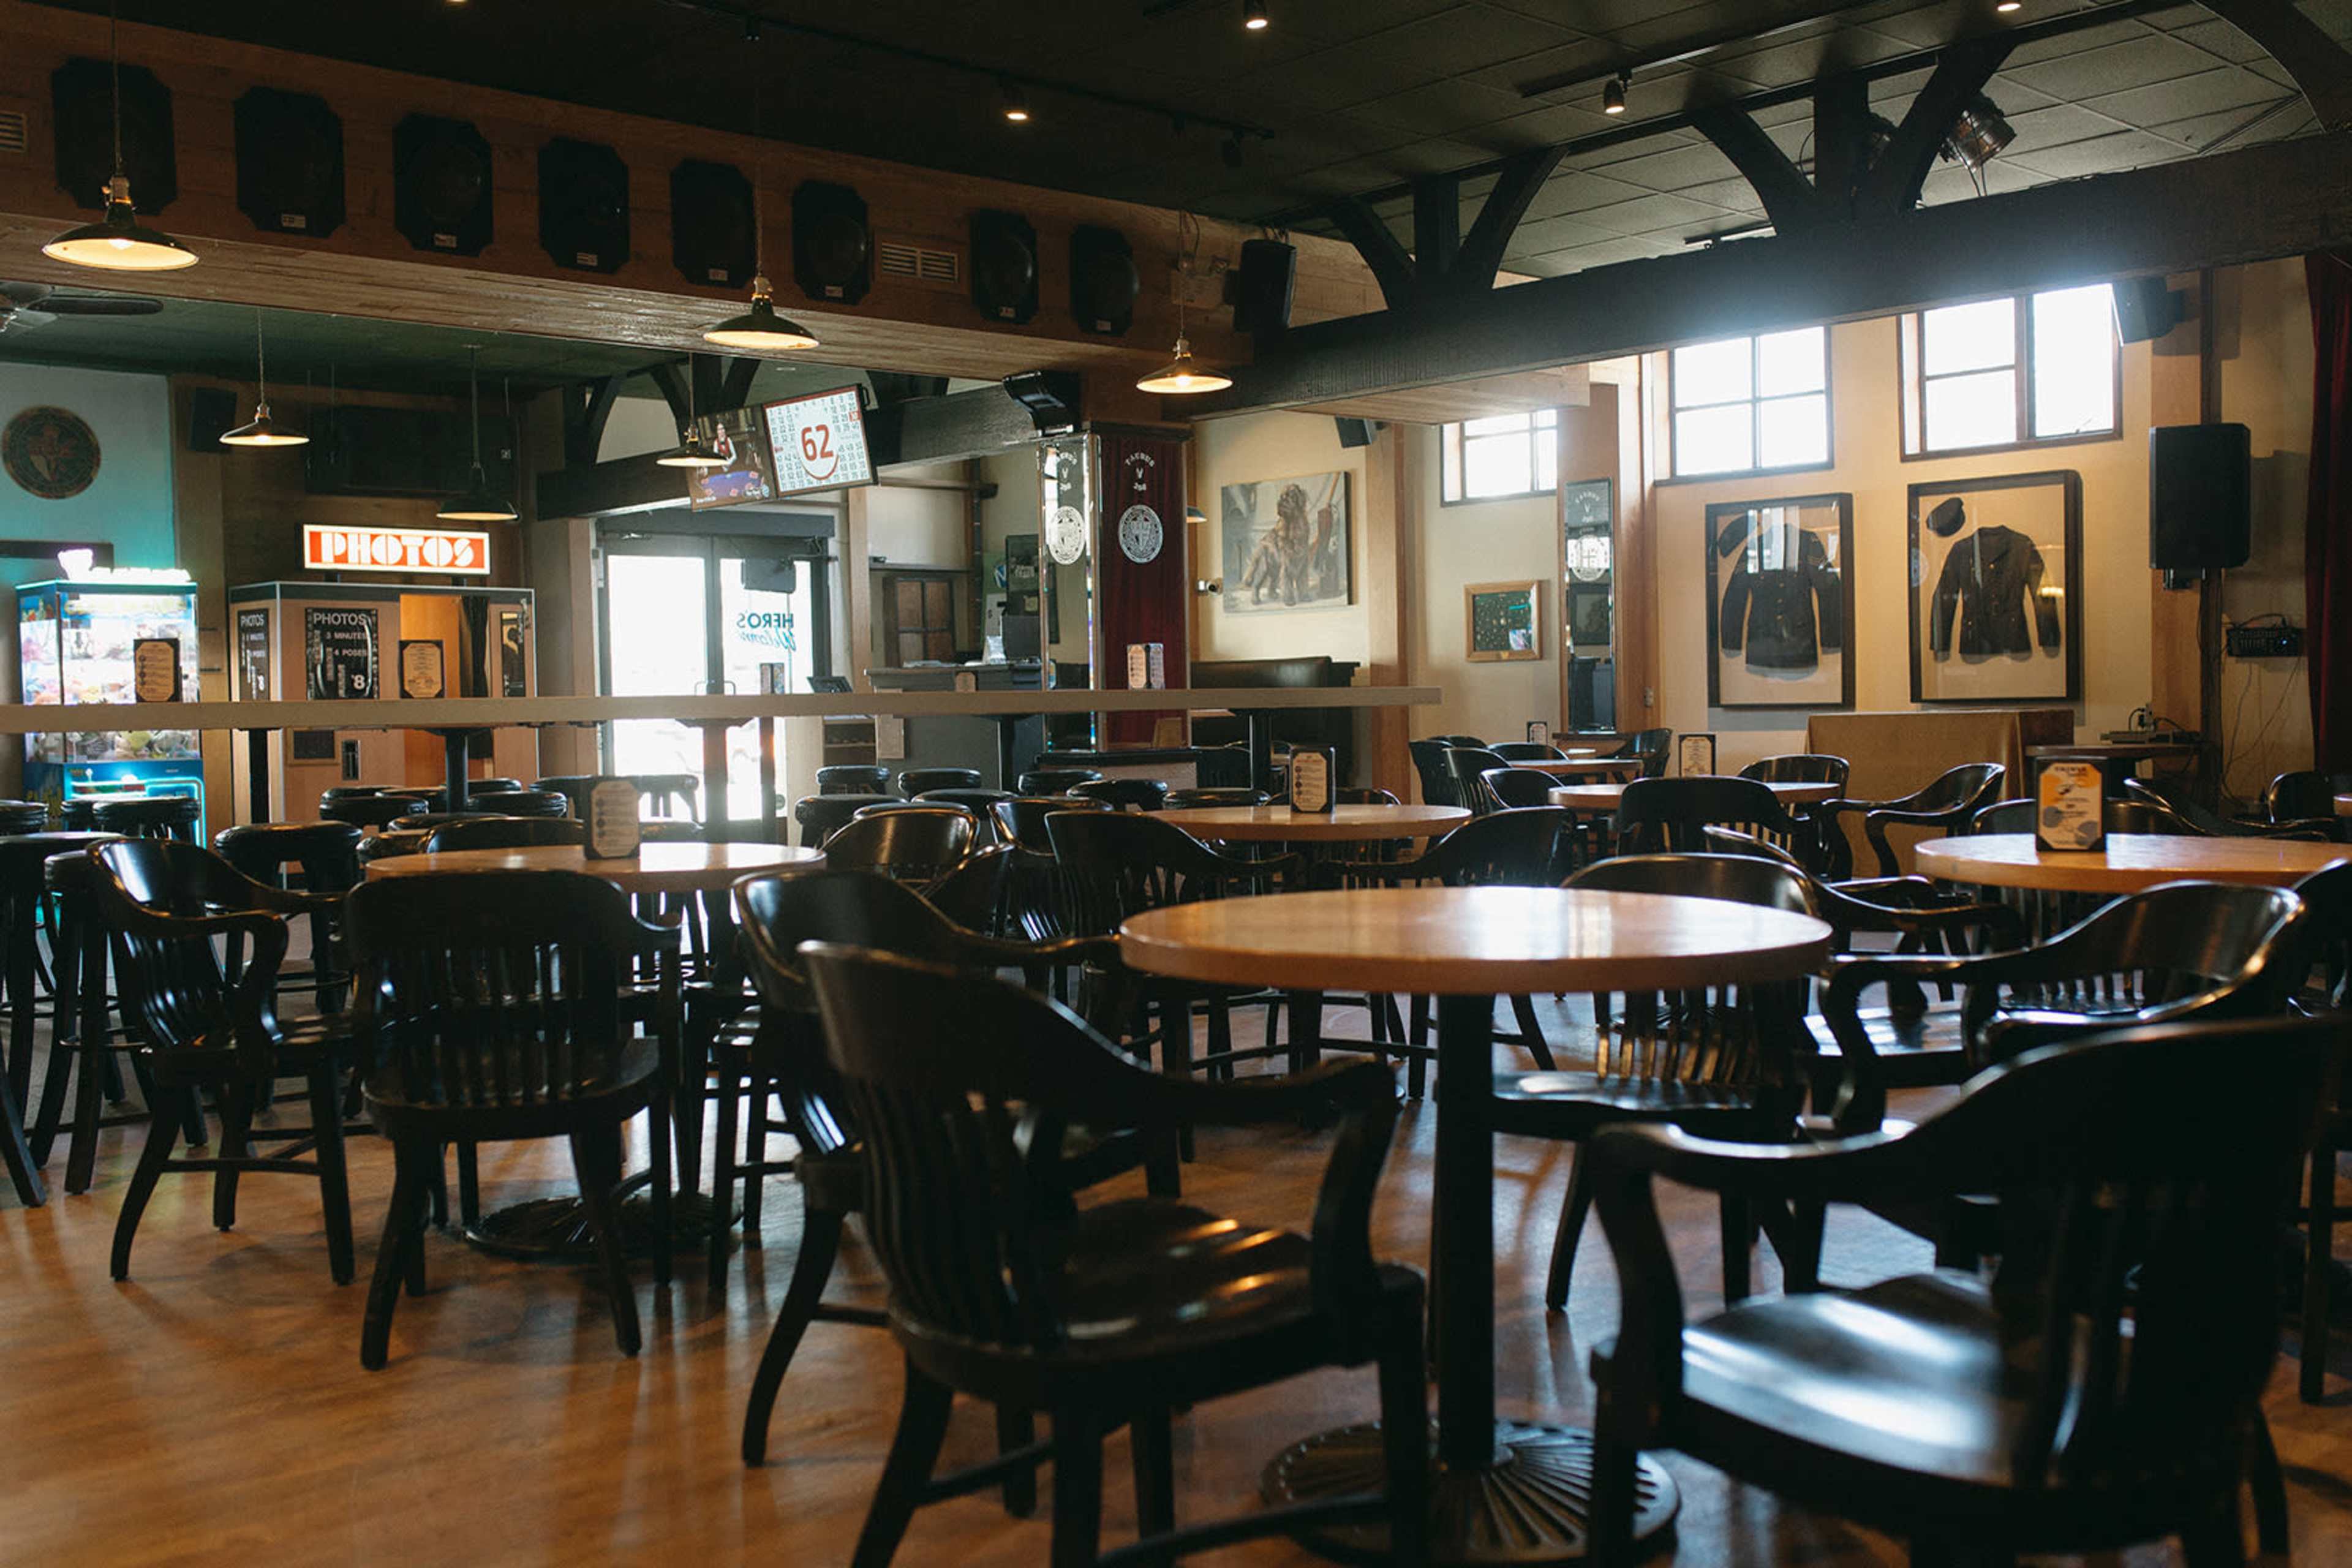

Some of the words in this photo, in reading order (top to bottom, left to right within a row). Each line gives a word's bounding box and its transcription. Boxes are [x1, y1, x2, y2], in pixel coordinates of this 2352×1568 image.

[801, 424, 834, 461] 62
[320, 532, 475, 567] PHOTOS
[241, 614, 265, 627] PHOTOS
[314, 612, 368, 625] PHOTOS
